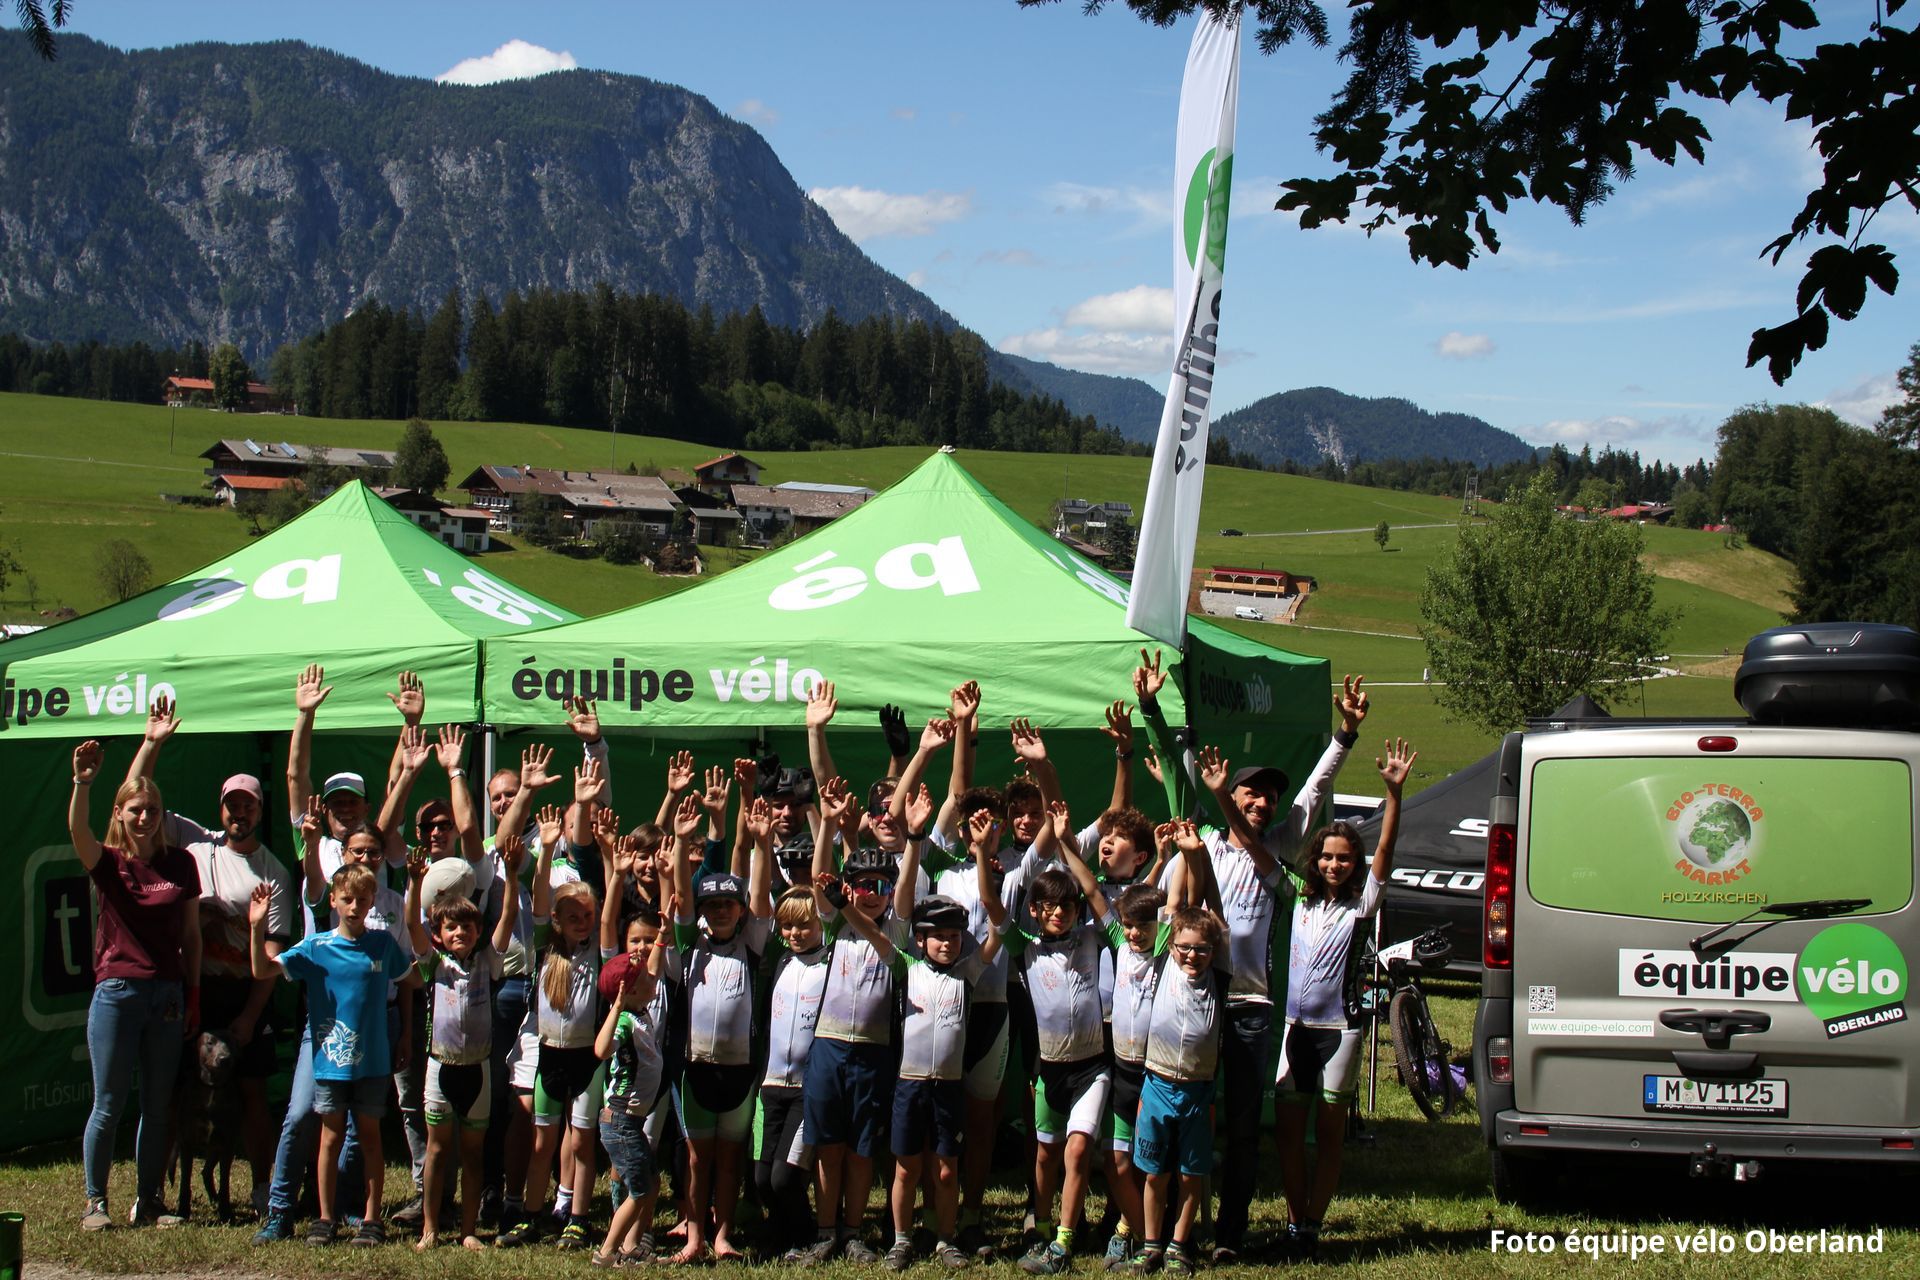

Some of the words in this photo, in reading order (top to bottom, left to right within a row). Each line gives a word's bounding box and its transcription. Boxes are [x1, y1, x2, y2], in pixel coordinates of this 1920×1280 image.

[767, 535, 982, 611] éq
[511, 655, 694, 711] équipe
[708, 655, 826, 703] vélo
[1246, 671, 1273, 714] vélo
[4, 678, 70, 726] ipe
[82, 671, 177, 716] vélo
[1665, 783, 1764, 822] BIO-TERRA
[1391, 868, 1485, 890] SCO
[1675, 858, 1752, 886] MARKT
[1661, 891, 1768, 904] HOLZKIRCHEN
[1633, 952, 1790, 997] équipe
[1801, 958, 1900, 996] vélo
[1530, 1021, 1653, 1035] www.equipe-velo.com
[1828, 1007, 1904, 1035] OBERLAND
[24, 1081, 91, 1111] IT-Lösun
[1665, 1080, 1680, 1102] M
[1716, 1083, 1773, 1105] 1125
